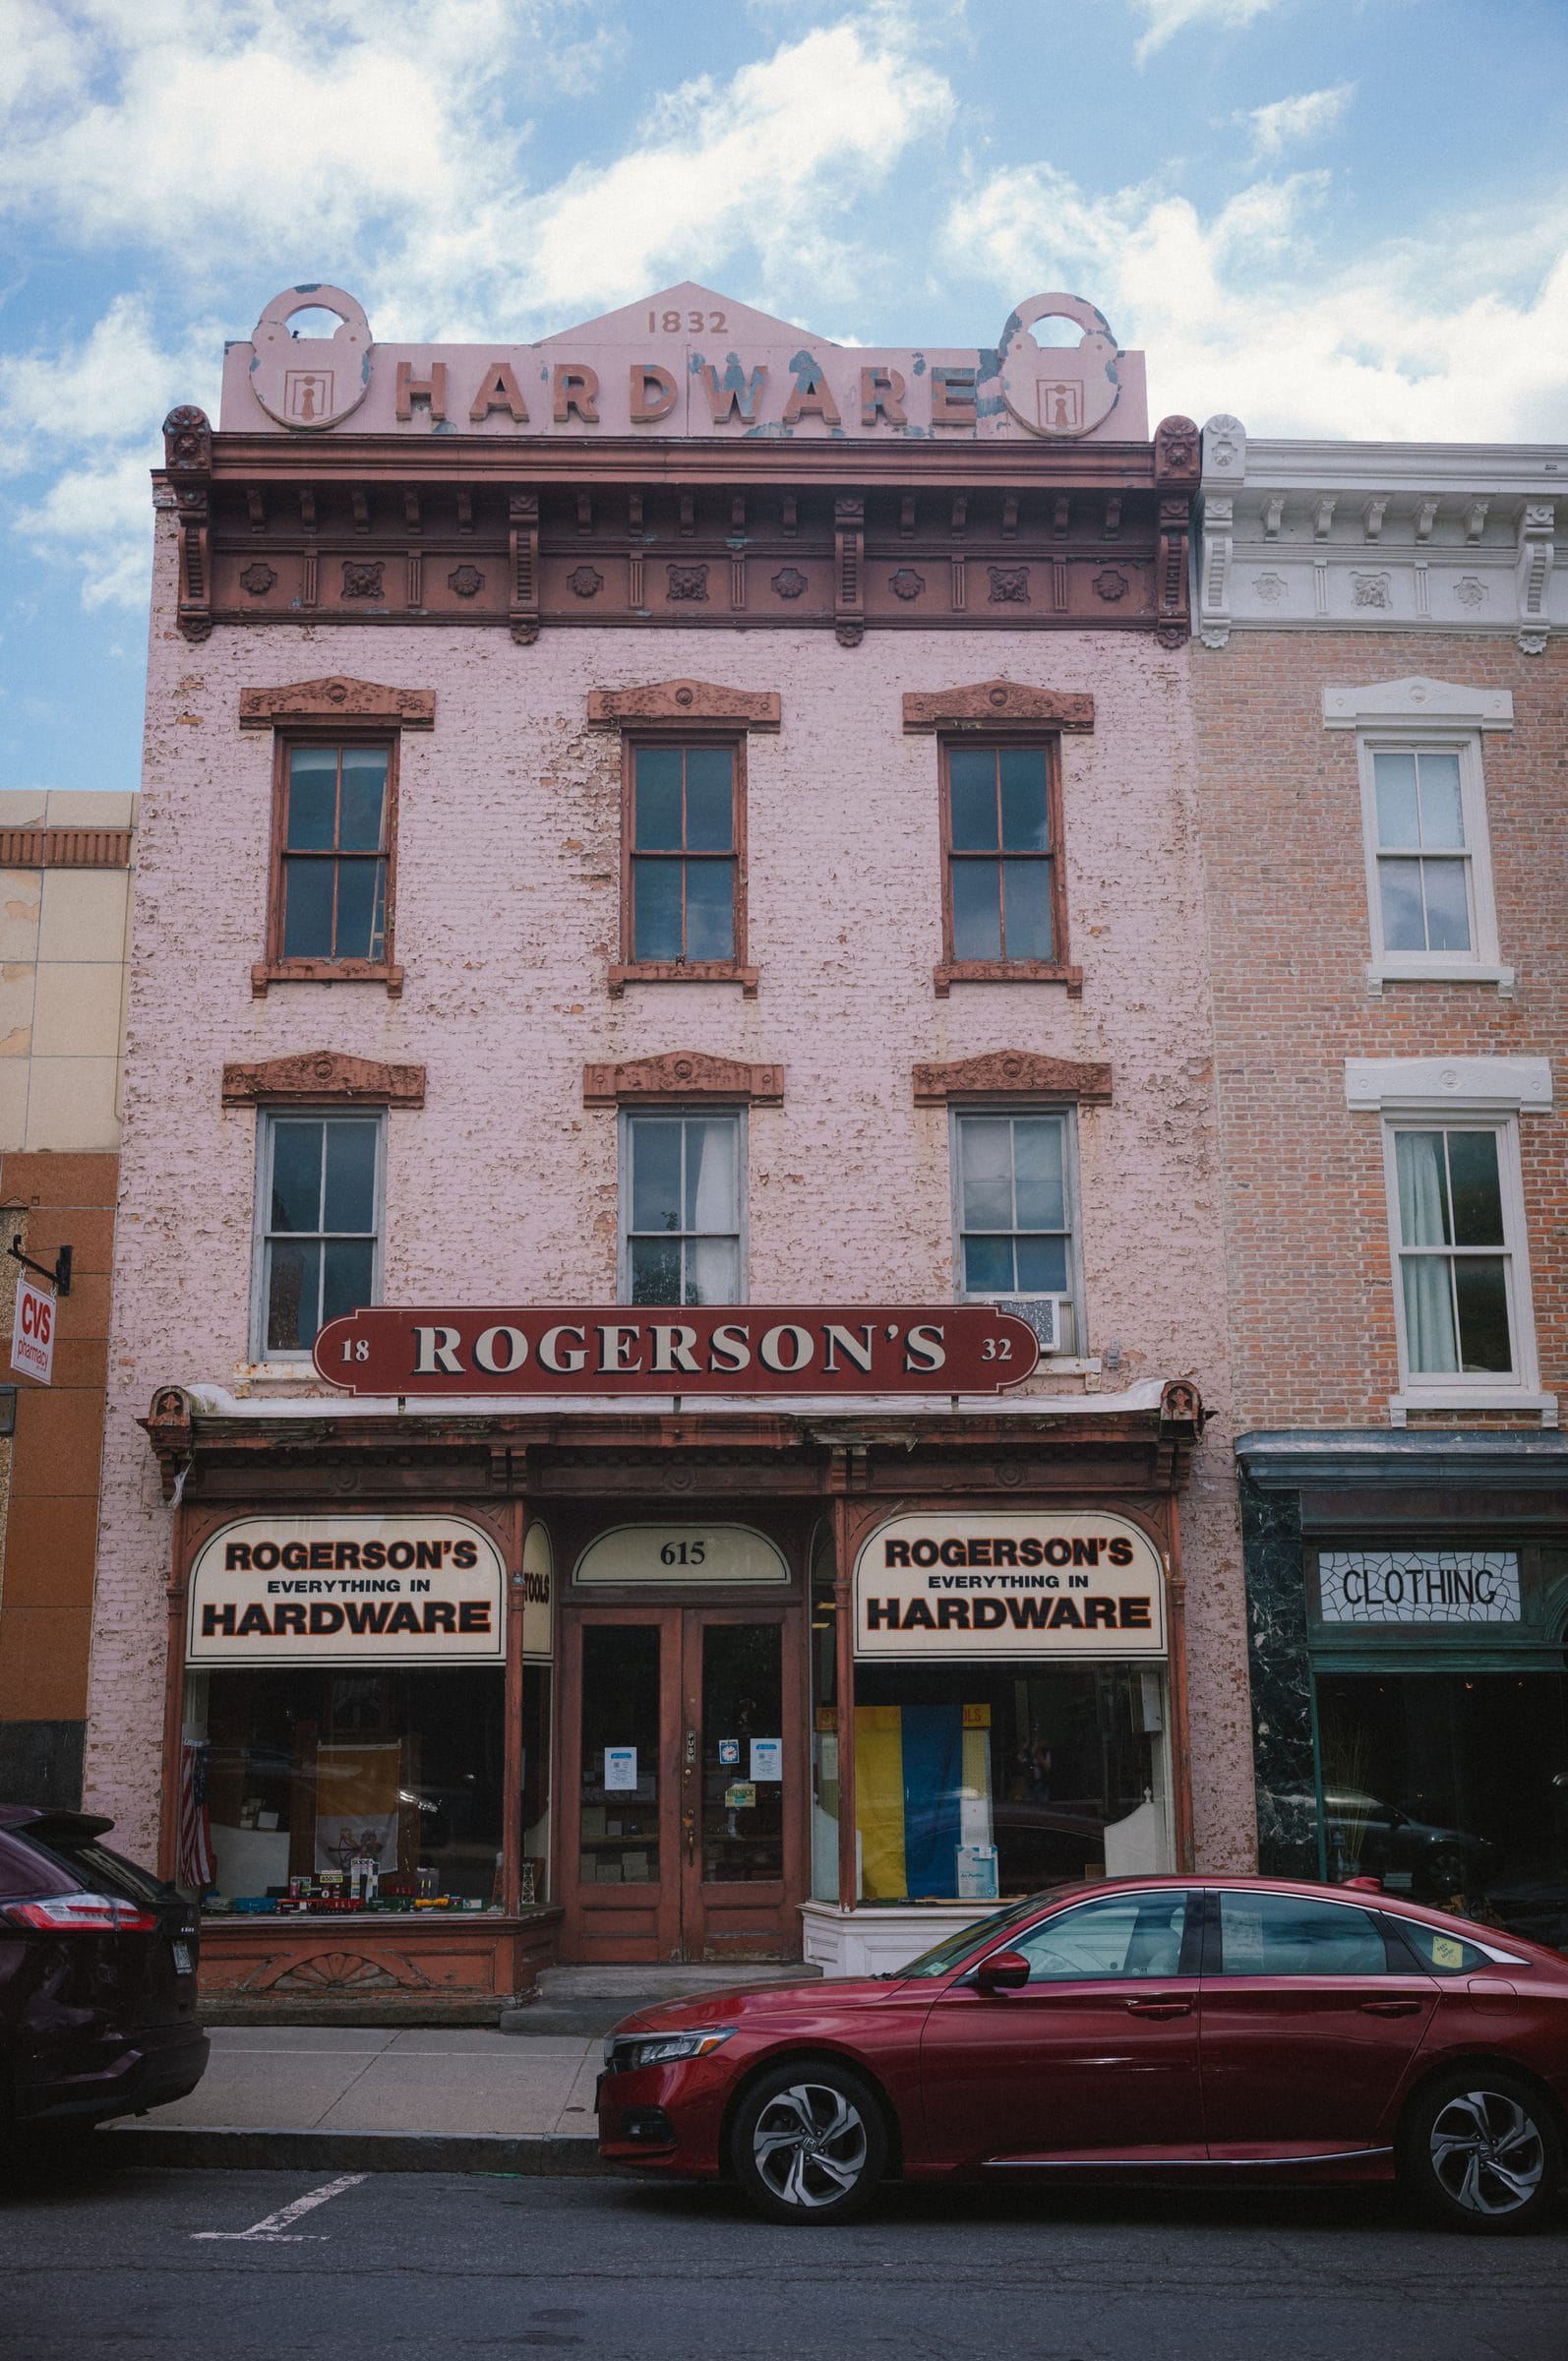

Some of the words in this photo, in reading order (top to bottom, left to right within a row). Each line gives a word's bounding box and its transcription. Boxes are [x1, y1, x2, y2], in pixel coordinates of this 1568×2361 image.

[647, 310, 729, 335] 1832
[395, 360, 978, 427] HARDWARE
[21, 1293, 51, 1345] CVS
[17, 1337, 48, 1371] pharmacy
[340, 1338, 370, 1362] 18
[413, 1324, 947, 1375] ROGERSON'S
[981, 1338, 1013, 1362] 32
[224, 1540, 479, 1571] ROGERSON'S
[660, 1541, 705, 1565] 615
[884, 1537, 1134, 1568] ROGERSON'S
[267, 1580, 401, 1594] EVERYTHING
[409, 1579, 431, 1592] IN
[523, 1572, 551, 1604] TOOLS
[928, 1575, 1059, 1589] EVERYTHING
[1068, 1575, 1089, 1588] IN
[1343, 1569, 1497, 1604] CLOTHING
[202, 1601, 492, 1637] HARDWARE
[866, 1596, 1152, 1630] HARDWARE
